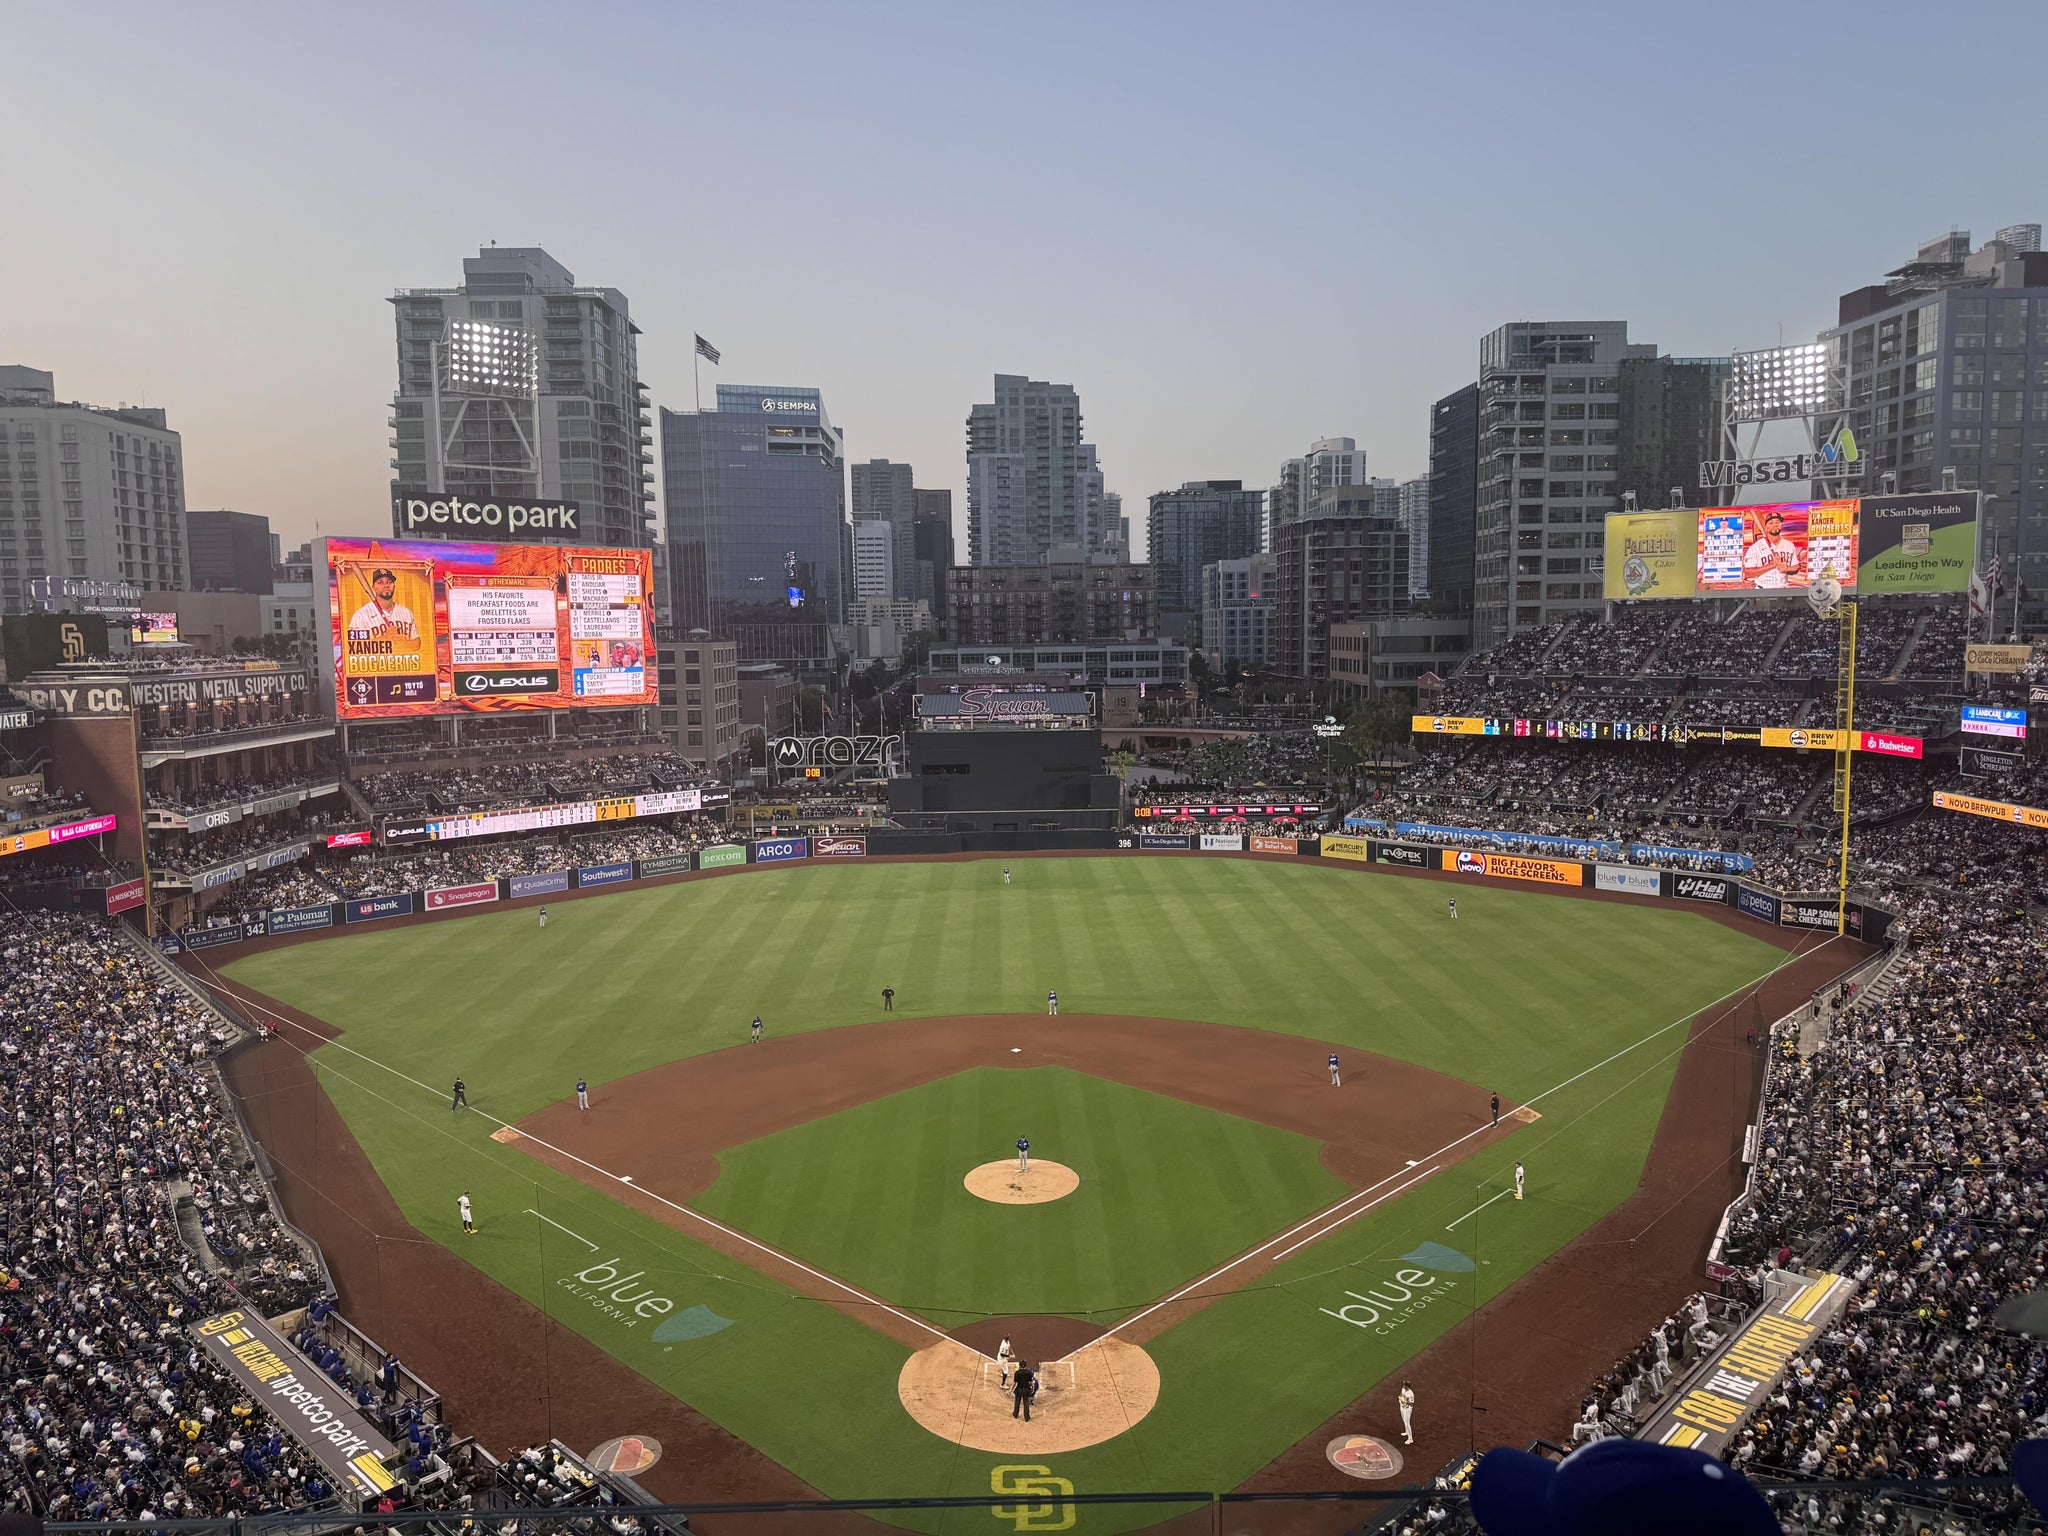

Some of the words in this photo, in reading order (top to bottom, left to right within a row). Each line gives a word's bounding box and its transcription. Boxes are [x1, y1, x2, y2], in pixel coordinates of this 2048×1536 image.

[777, 401, 817, 411] SEMPRA
[1702, 454, 1811, 487] Viasat
[407, 496, 502, 529] petco
[508, 505, 577, 533] park
[1875, 508, 1890, 518] UC
[1890, 508, 1907, 516] San
[1907, 507, 1931, 517] Diego
[1933, 505, 1961, 514] Health
[1904, 525, 1928, 533] BEST
[582, 558, 626, 574] PADRES
[1875, 560, 1918, 570] Leading
[1921, 559, 1938, 568] the
[1941, 559, 1964, 568] Way
[1875, 573, 1884, 581] in
[1887, 573, 1905, 581] San
[1909, 572, 1935, 581] Diego
[64, 579, 142, 601] QuidelOrtho
[507, 617, 531, 625] FLAKES
[350, 631, 355, 640] 2
[359, 630, 368, 639] SS
[348, 640, 393, 655] XANDER
[349, 654, 421, 673] BOGAERTS
[132, 680, 197, 705] WESTERN
[202, 678, 243, 700] METAL
[245, 675, 286, 695] SUPPLY
[290, 674, 308, 691] CO.
[489, 677, 549, 687] LEXUS
[88, 688, 130, 712] CO.
[959, 688, 1050, 721] Sycuan
[1312, 724, 1345, 732] Gallagher
[807, 735, 900, 767] razr
[1878, 740, 1915, 754] Budweiser
[1980, 754, 2013, 765] SINGLETON
[601, 808, 607, 819] 2
[615, 806, 619, 817] 1
[628, 804, 632, 816] 1
[1949, 798, 1970, 809] NOVO
[1971, 803, 2006, 816] BREWPUB
[206, 811, 230, 827] ORIS
[62, 828, 74, 837] BAJA
[75, 821, 102, 833] CALIFORNIA
[817, 838, 861, 855] Sycuan
[1118, 839, 1131, 848] 396
[1215, 837, 1240, 845] National
[1264, 842, 1279, 850] Safari
[1280, 843, 1293, 851] Park
[268, 849, 297, 867] Canel's
[704, 851, 741, 863] dexcom
[758, 844, 792, 858] ARCO
[642, 857, 688, 870] CYMBIOTIKA
[1461, 863, 1482, 873] NOVO
[1491, 857, 1508, 867] BIG
[1509, 860, 1559, 873] FLAVORS,
[204, 866, 238, 888] Canel's
[582, 867, 624, 882] Southwest
[1491, 866, 1519, 877] HUGE
[1520, 869, 1568, 882] SCREENS.
[1597, 871, 1617, 882] blue
[1628, 875, 1649, 885] blue
[524, 877, 565, 890] QuidelOrtho
[448, 889, 490, 901] Snapdragon
[1692, 890, 1724, 900] POWER
[360, 904, 373, 913] us
[374, 900, 398, 912] bank
[1749, 895, 1773, 912] petco
[287, 910, 328, 923] Palomar
[1798, 907, 1818, 918] SLAP
[1818, 910, 1840, 920] SOME
[1798, 915, 1822, 925] CHEESE
[246, 923, 264, 936] 342
[273, 922, 300, 930] SPECIALTY
[301, 917, 329, 926] INSURANCE
[574, 1258, 674, 1318] blue
[557, 1278, 638, 1328] CALIFORNIA
[1318, 1269, 1436, 1329] blue
[1375, 1280, 1458, 1336] CALIFORNIA
[198, 1311, 245, 1336] SD
[1717, 1313, 1816, 1382] FAITHFUL
[1704, 1369, 1760, 1401] THE
[230, 1339, 292, 1383] WELCOME
[273, 1382, 333, 1424] petco
[311, 1419, 370, 1458] park
[1672, 1389, 1747, 1434] FOR
[990, 1464, 1077, 1532] SD
